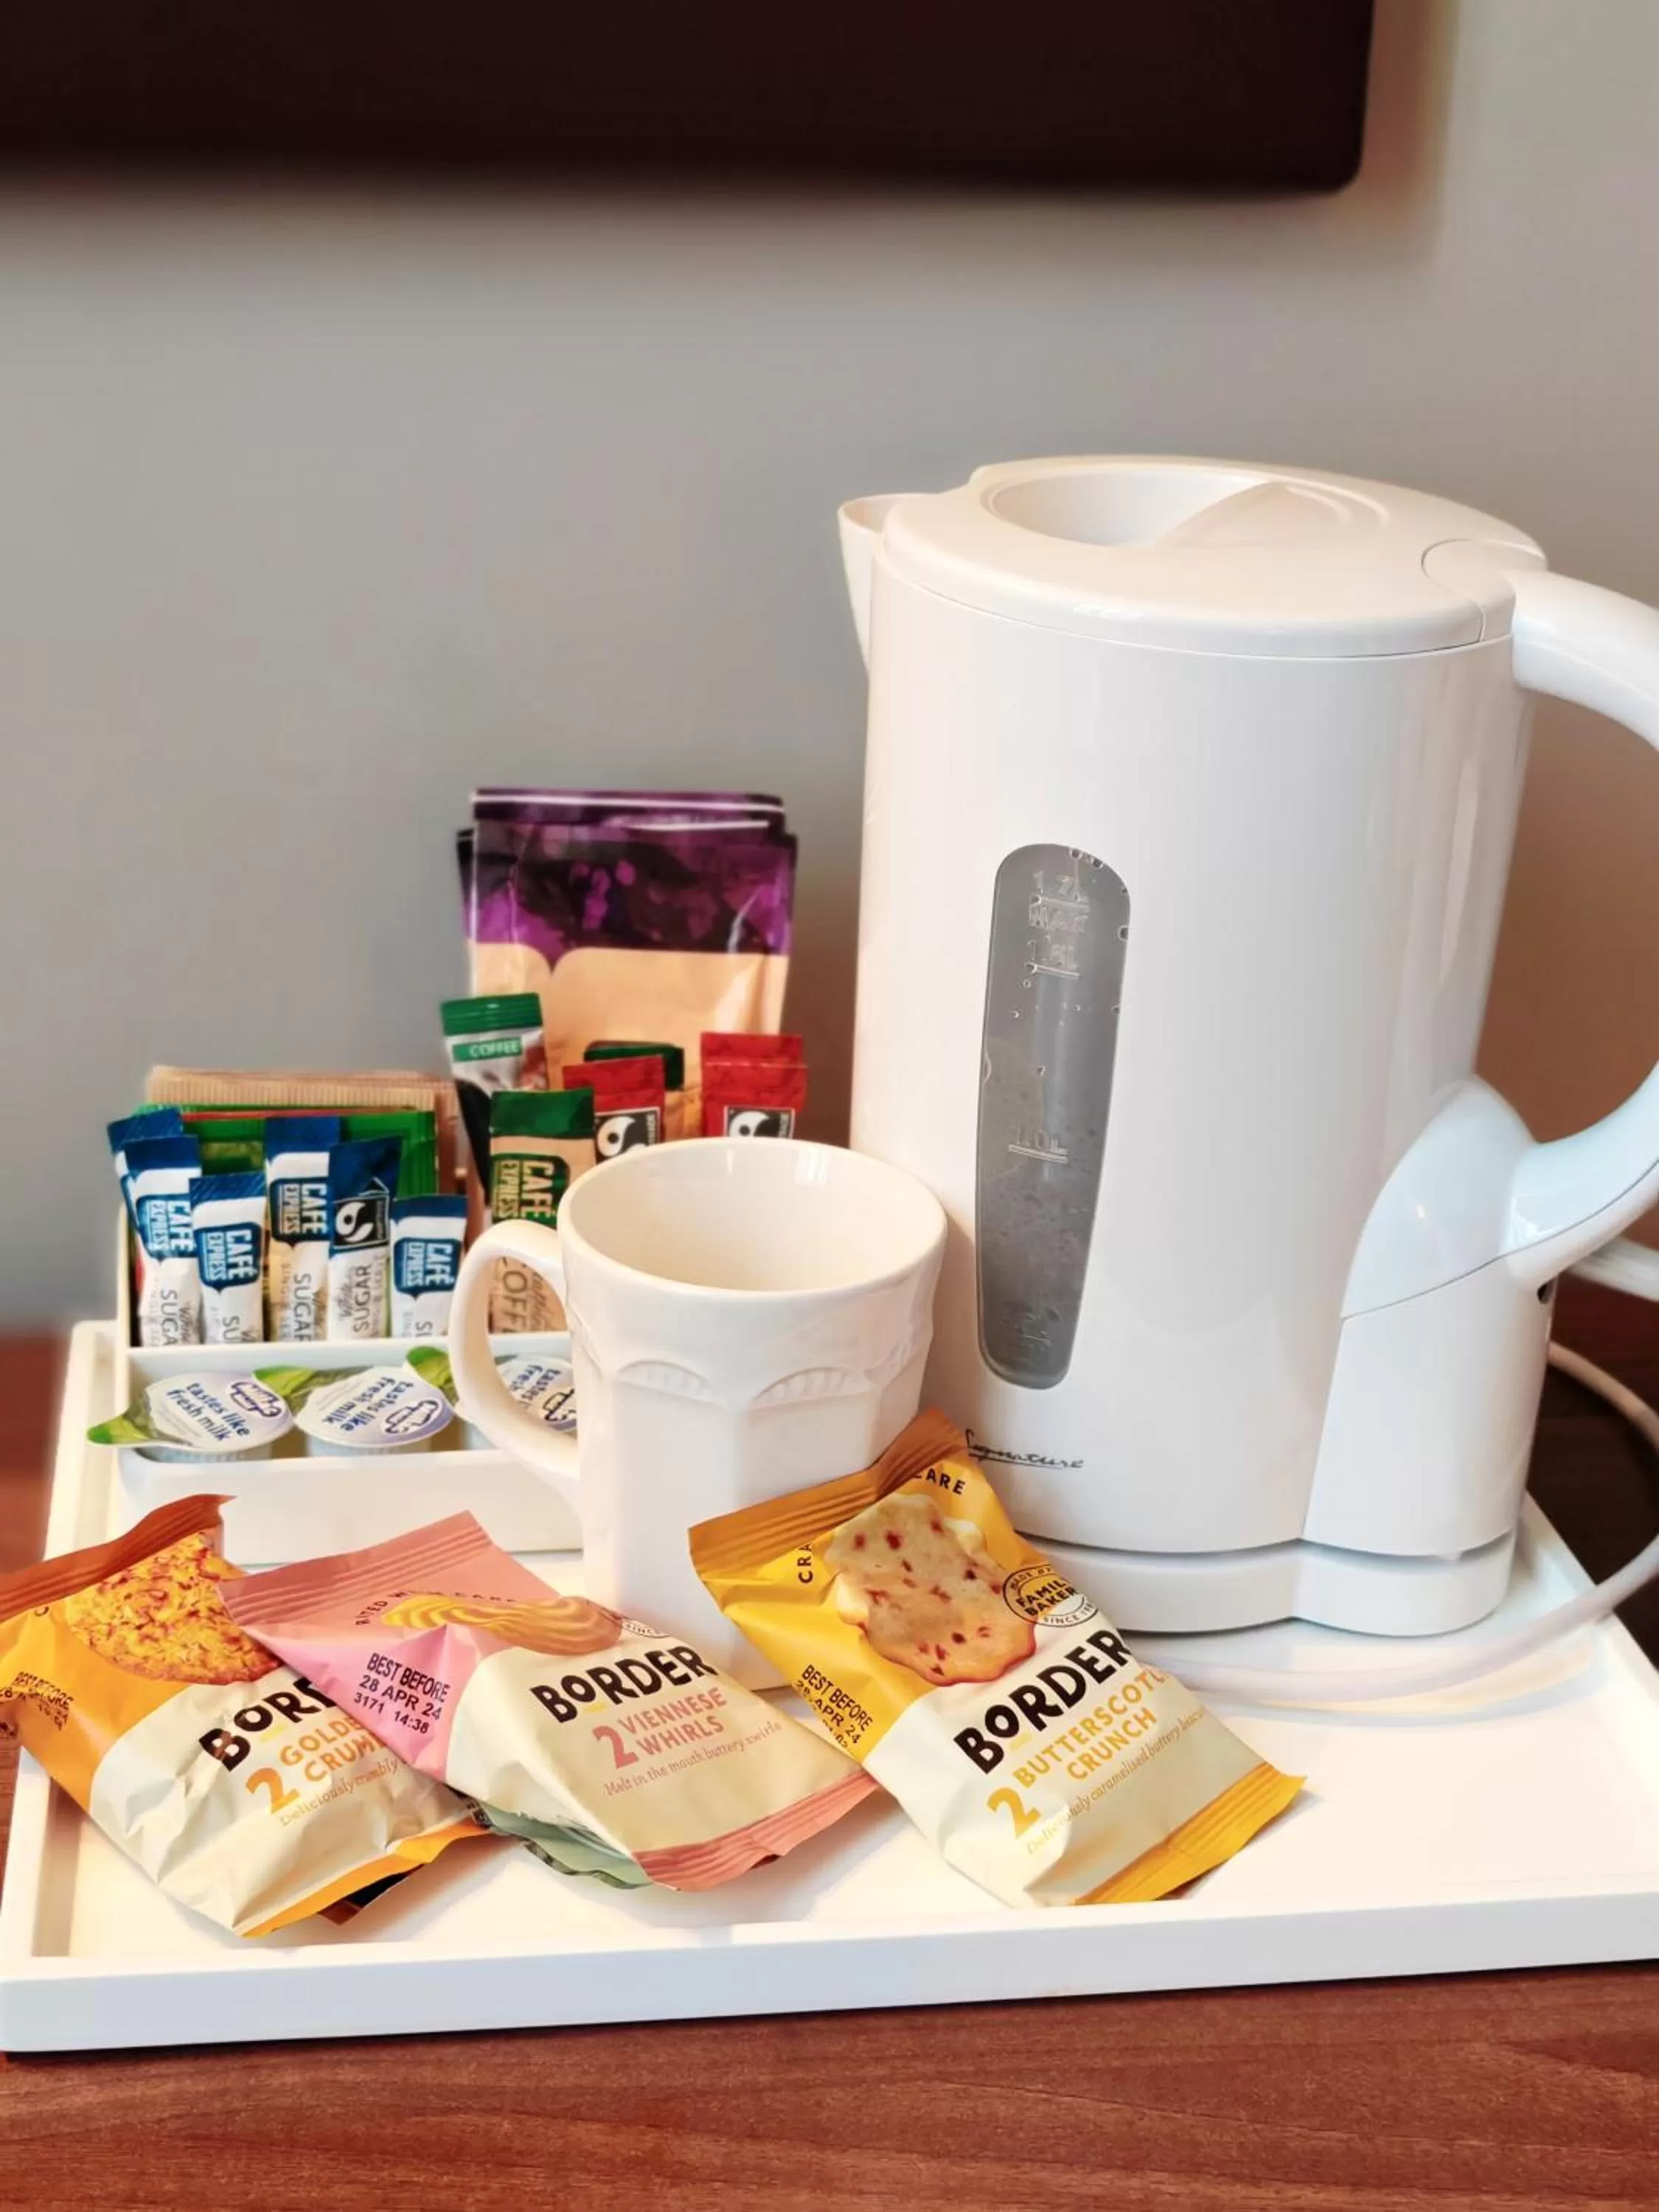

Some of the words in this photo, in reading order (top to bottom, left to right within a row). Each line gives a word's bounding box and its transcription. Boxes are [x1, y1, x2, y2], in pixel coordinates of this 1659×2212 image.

[469, 1039, 521, 1058] COFFEE
[160, 1289, 178, 1346] SUGA
[354, 1264, 372, 1333] SUGAR
[167, 1388, 204, 1418] fresh
[198, 1416, 232, 1442] milk
[222, 1412, 250, 1437] like
[914, 1468, 967, 1495] ARE
[1015, 1580, 1067, 1609] FAMIL
[359, 1674, 380, 1694] 28
[382, 1685, 420, 1711] APR
[422, 1701, 443, 1720] 24
[366, 1652, 403, 1681] BEST
[399, 1666, 451, 1703] BEFORE
[529, 1646, 720, 1724] BORDER
[801, 1663, 834, 1696] BEST
[829, 1688, 874, 1732] BEFORE
[953, 1630, 1133, 1775] BORDER
[198, 1676, 338, 1773] BOR
[354, 1691, 385, 1715] 3171
[394, 1710, 430, 1735] 14:38
[592, 1724, 639, 1771] 2
[617, 1686, 728, 1736] VIENNESE
[635, 1714, 726, 1756] WHIRLS
[814, 1697, 845, 1728] APR
[845, 1724, 862, 1745] 24
[1066, 1706, 1157, 1781] CRUNCH
[246, 1767, 300, 1815] 2
[632, 1775, 650, 1789] in
[647, 1765, 669, 1781] the
[667, 1750, 705, 1775] mouth
[986, 1787, 1042, 1840] 2
